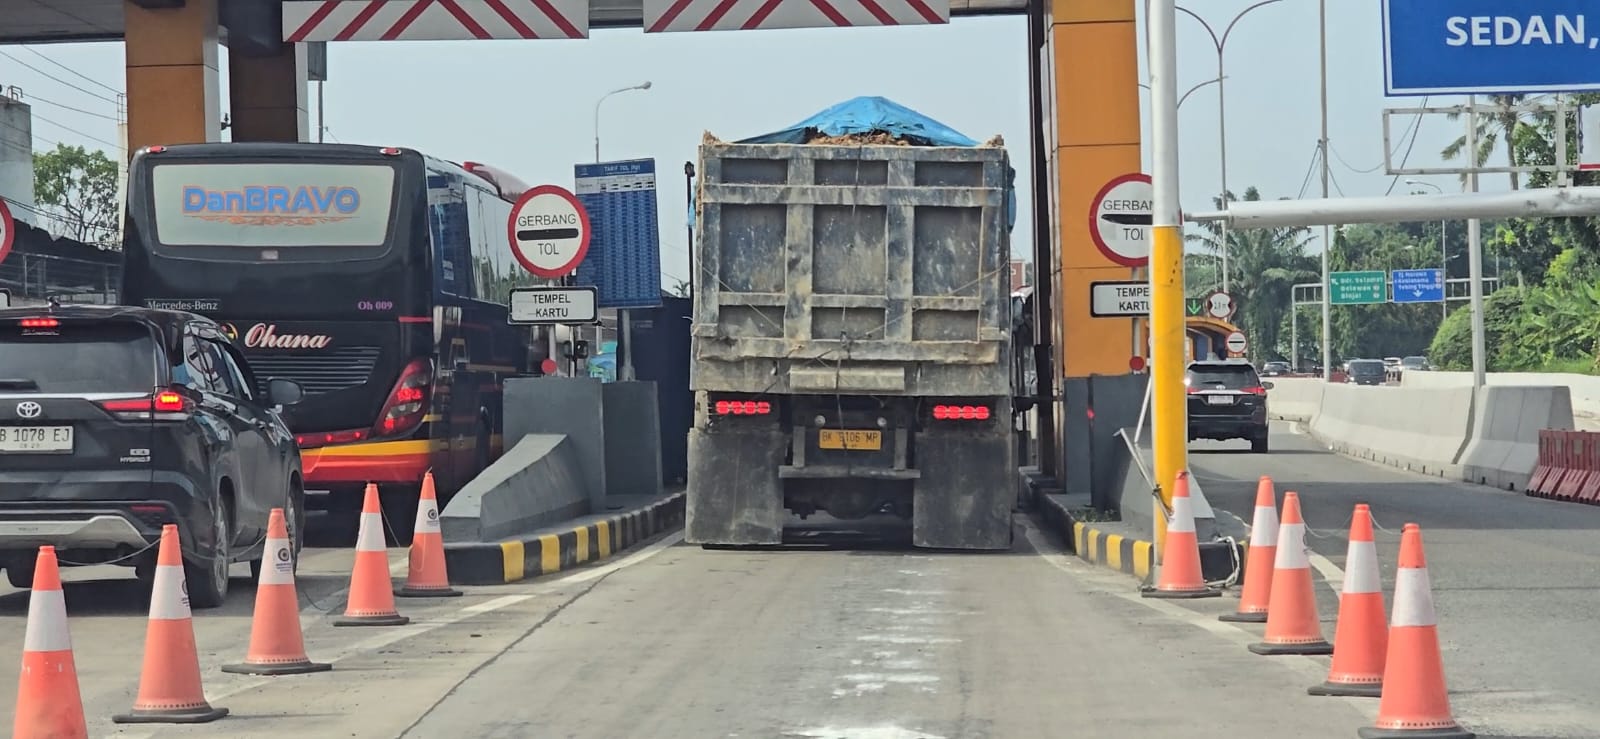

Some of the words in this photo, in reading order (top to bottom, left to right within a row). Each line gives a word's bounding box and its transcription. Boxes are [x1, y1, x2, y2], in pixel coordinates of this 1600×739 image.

[1446, 15, 1599, 49] SEDAN,
[182, 186, 360, 214] DanBRAVO
[518, 213, 576, 226] GERBANG
[538, 242, 559, 255] TOL
[1116, 288, 1150, 297] TEMPE
[147, 300, 218, 310] Mercedes-Benz
[533, 294, 571, 304] TEMPEL
[358, 301, 373, 310] Oh
[376, 301, 392, 310] 009
[536, 308, 568, 317] KARTU
[244, 322, 332, 348] Ohana
[0, 428, 6, 442] B
[14, 428, 45, 442] 1078
[54, 428, 70, 442] EJ
[822, 431, 832, 442] BK
[866, 432, 879, 443] MP
